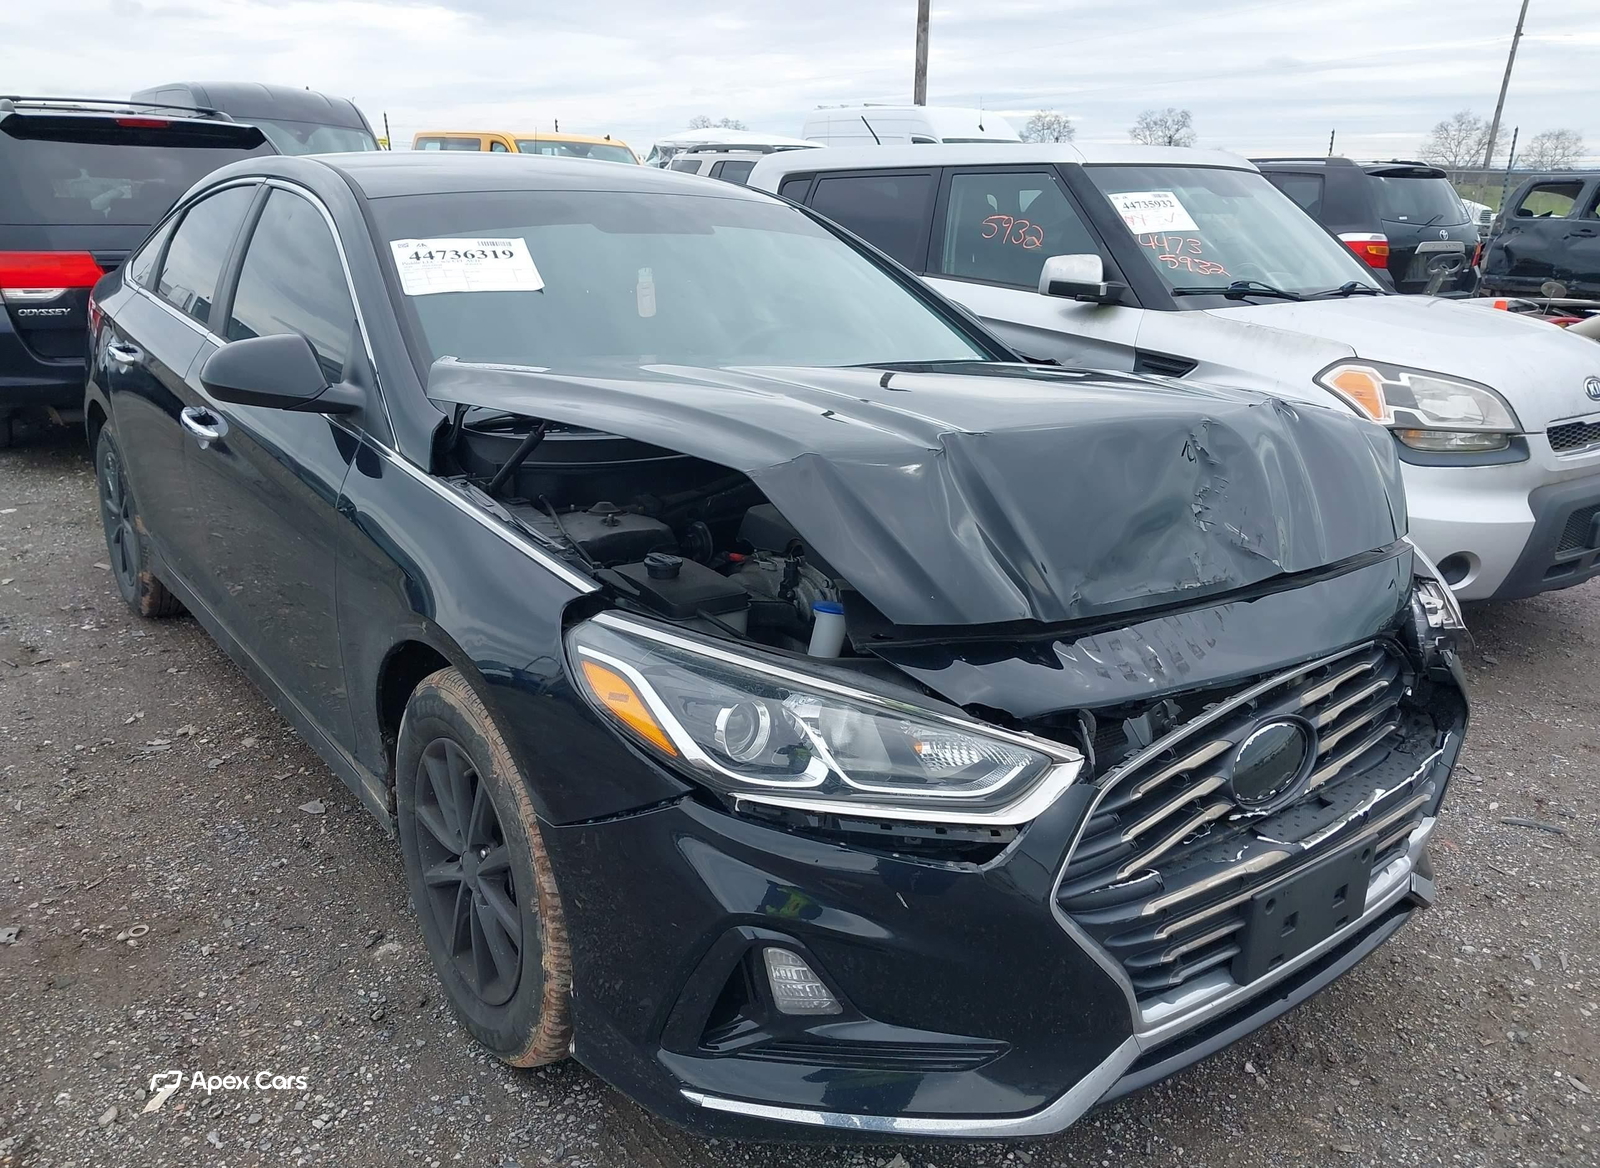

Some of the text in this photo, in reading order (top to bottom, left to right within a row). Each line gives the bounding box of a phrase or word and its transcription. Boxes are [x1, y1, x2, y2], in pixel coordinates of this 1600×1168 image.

[1122, 199, 1175, 210] 44735932
[981, 214, 1044, 249] 5932
[1138, 234, 1202, 254] 4473
[409, 249, 514, 261] 44736319
[1158, 254, 1231, 277] 5932
[18, 308, 71, 317] ODYSSEY
